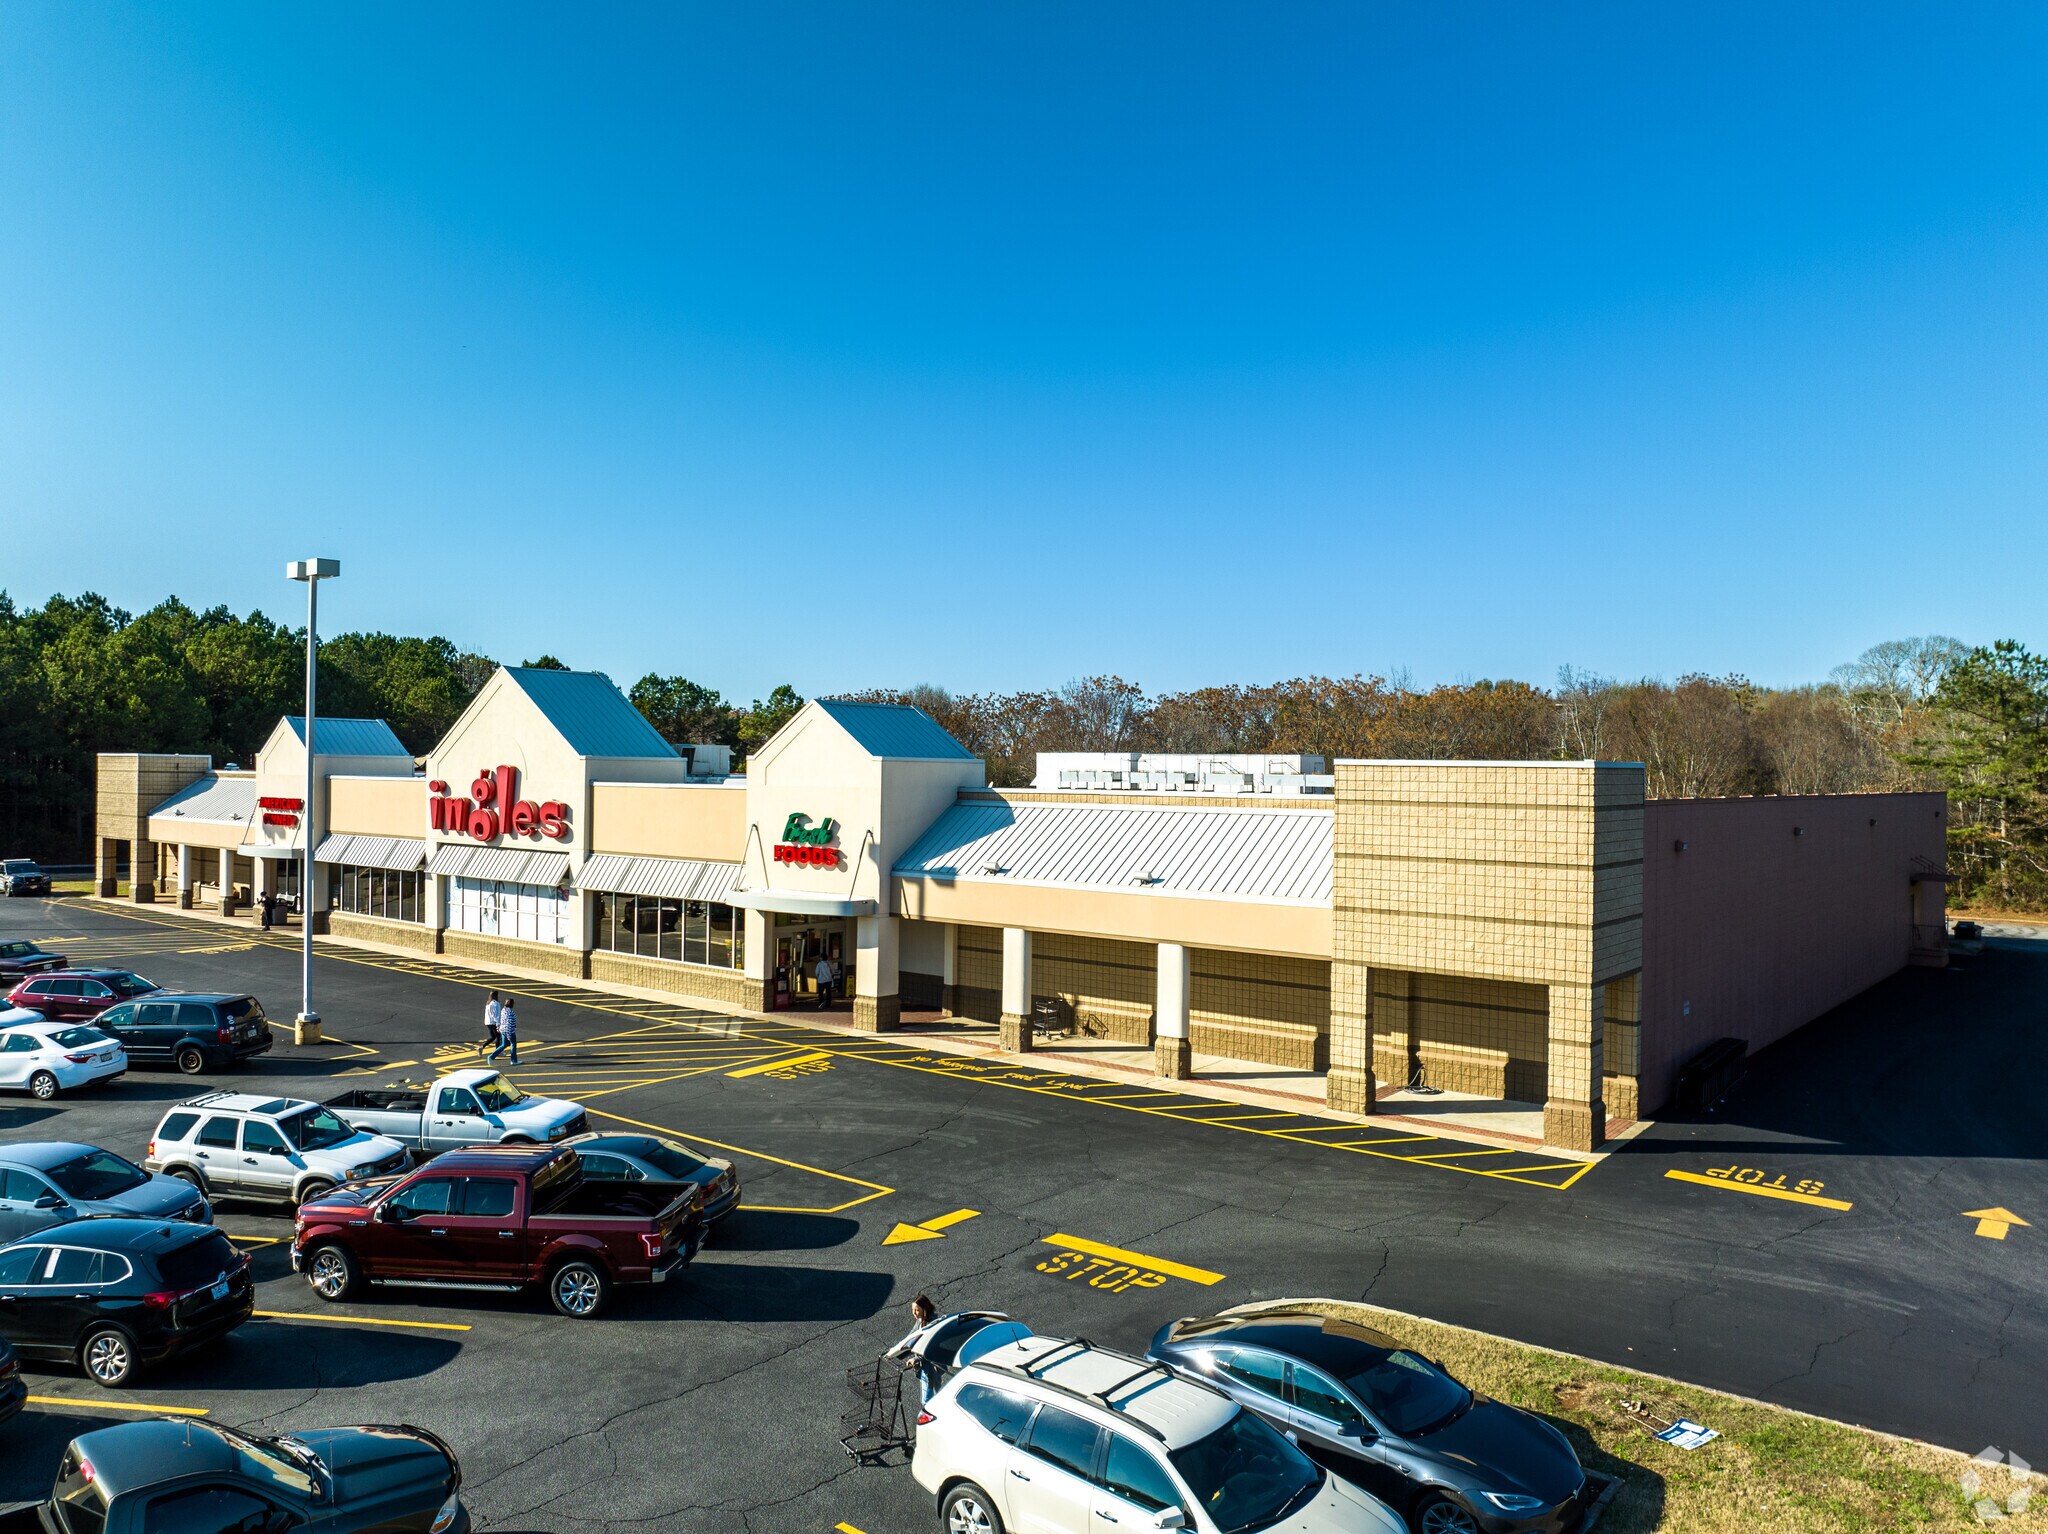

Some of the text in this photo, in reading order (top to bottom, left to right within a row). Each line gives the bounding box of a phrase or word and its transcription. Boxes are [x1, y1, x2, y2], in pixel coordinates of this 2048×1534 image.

[429, 764, 567, 841] ingles
[782, 812, 833, 844] Fresh
[774, 845, 839, 866] FOODS
[764, 1060, 836, 1080] STOP
[1705, 1165, 1825, 1195] STOP
[1036, 1252, 1167, 1293] STOP
